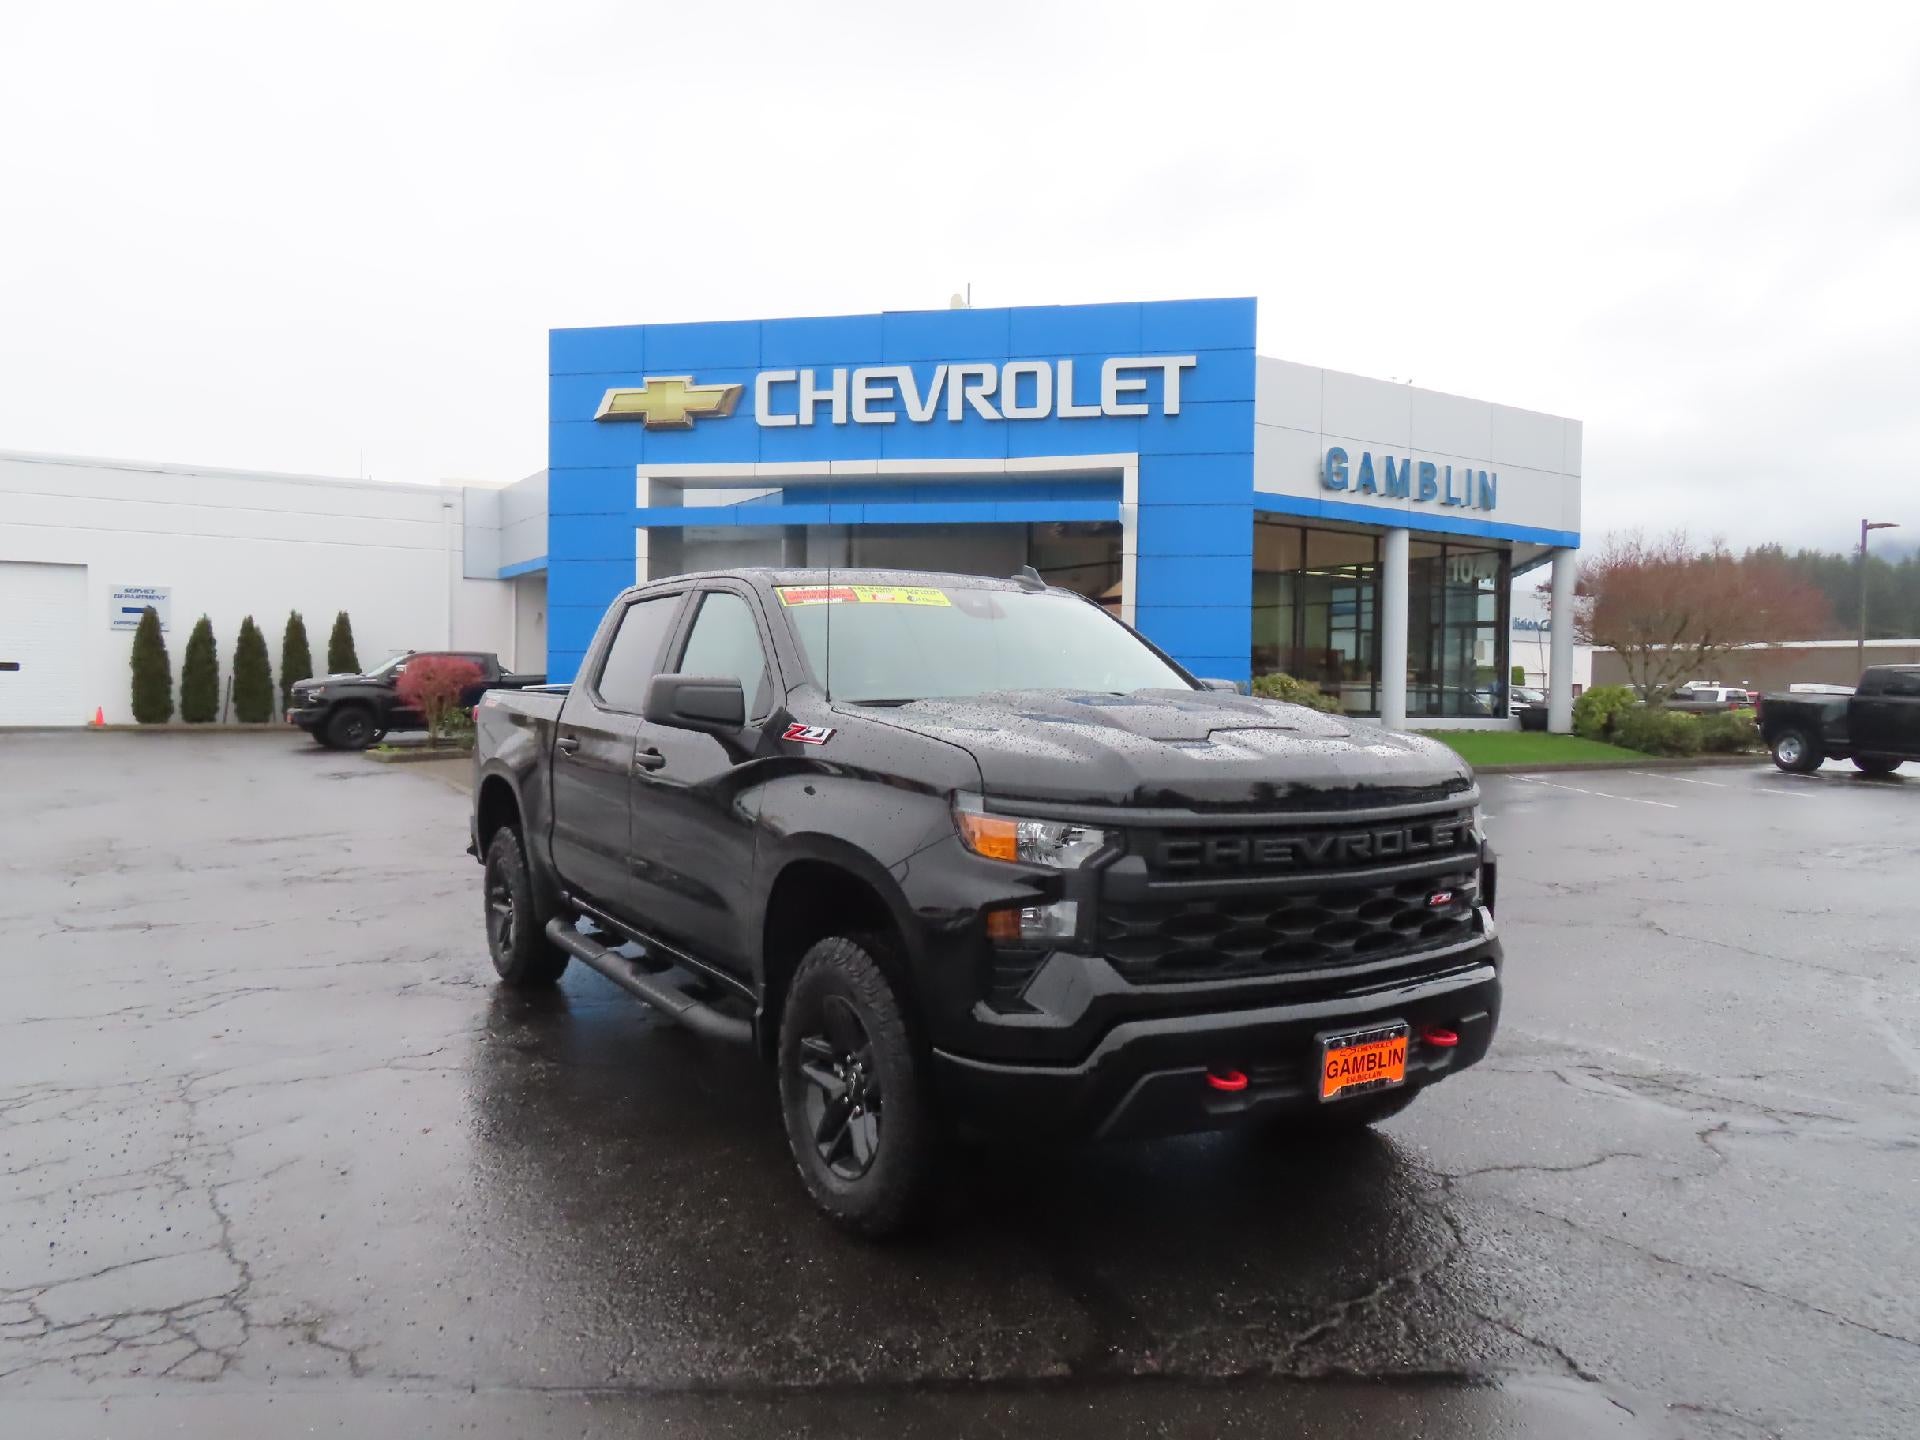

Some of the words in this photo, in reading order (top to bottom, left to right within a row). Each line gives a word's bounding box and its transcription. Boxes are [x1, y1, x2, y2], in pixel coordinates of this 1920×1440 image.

[755, 355, 1196, 427] CHEVROLET
[1321, 446, 1497, 511] GAMBLIN
[1326, 1047, 1404, 1079] GAMBLIN
